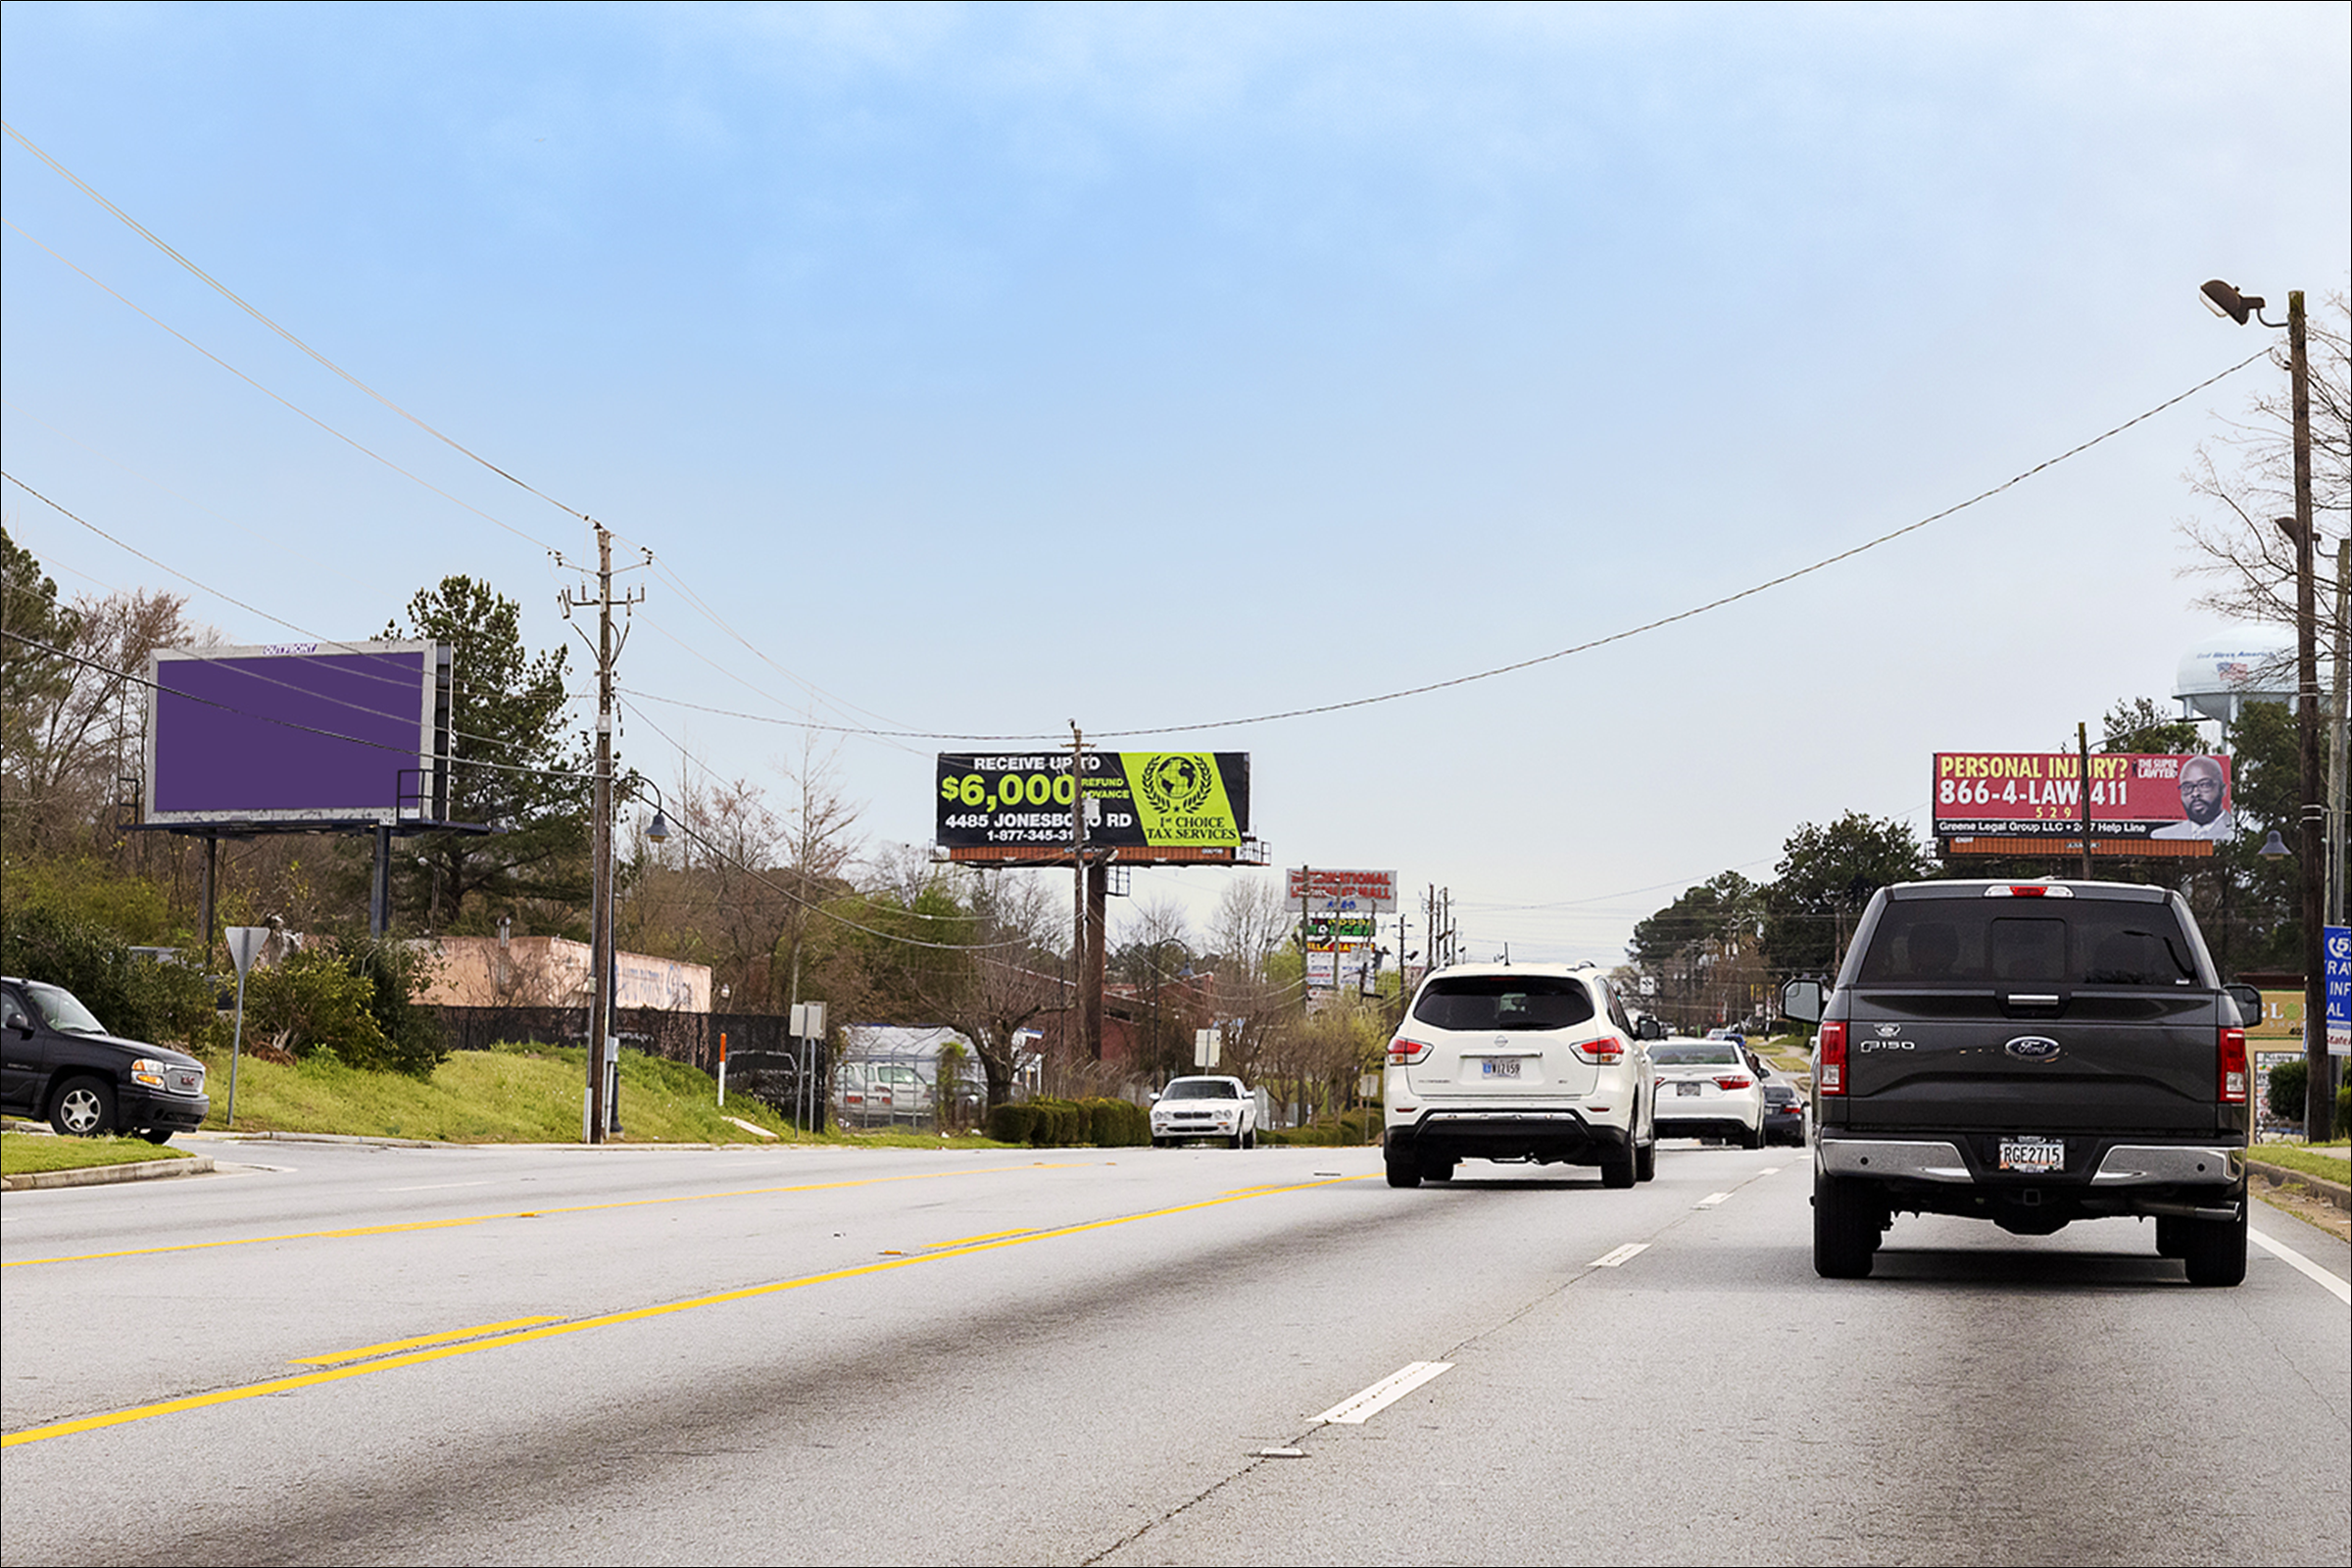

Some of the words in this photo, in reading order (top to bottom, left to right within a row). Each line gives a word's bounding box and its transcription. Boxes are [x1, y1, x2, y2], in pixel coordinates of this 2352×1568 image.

[973, 757, 1045, 771] RECEIVE
[1050, 757, 1073, 771] UP
[1941, 757, 2043, 778] PERSONAL
[1081, 778, 1124, 788] REFUND
[941, 773, 1076, 812] $6,000
[1080, 790, 1130, 800] ADVANCE
[945, 813, 990, 828] 4485
[994, 812, 1102, 828] JONESBOO
[1106, 813, 1133, 828] RD
[1175, 816, 1225, 828] CHOICE
[1147, 828, 1172, 840] TAX
[1176, 828, 1237, 840] SERVICES
[1939, 822, 1976, 831] Greene
[1979, 822, 2006, 832] Legal
[2009, 822, 2040, 833] Group
[2042, 823, 2064, 832] LLC
[2098, 823, 2122, 834] Help
[986, 829, 1091, 841] 1-877-345-313
[2004, 1147, 2060, 1163] RGE2715
